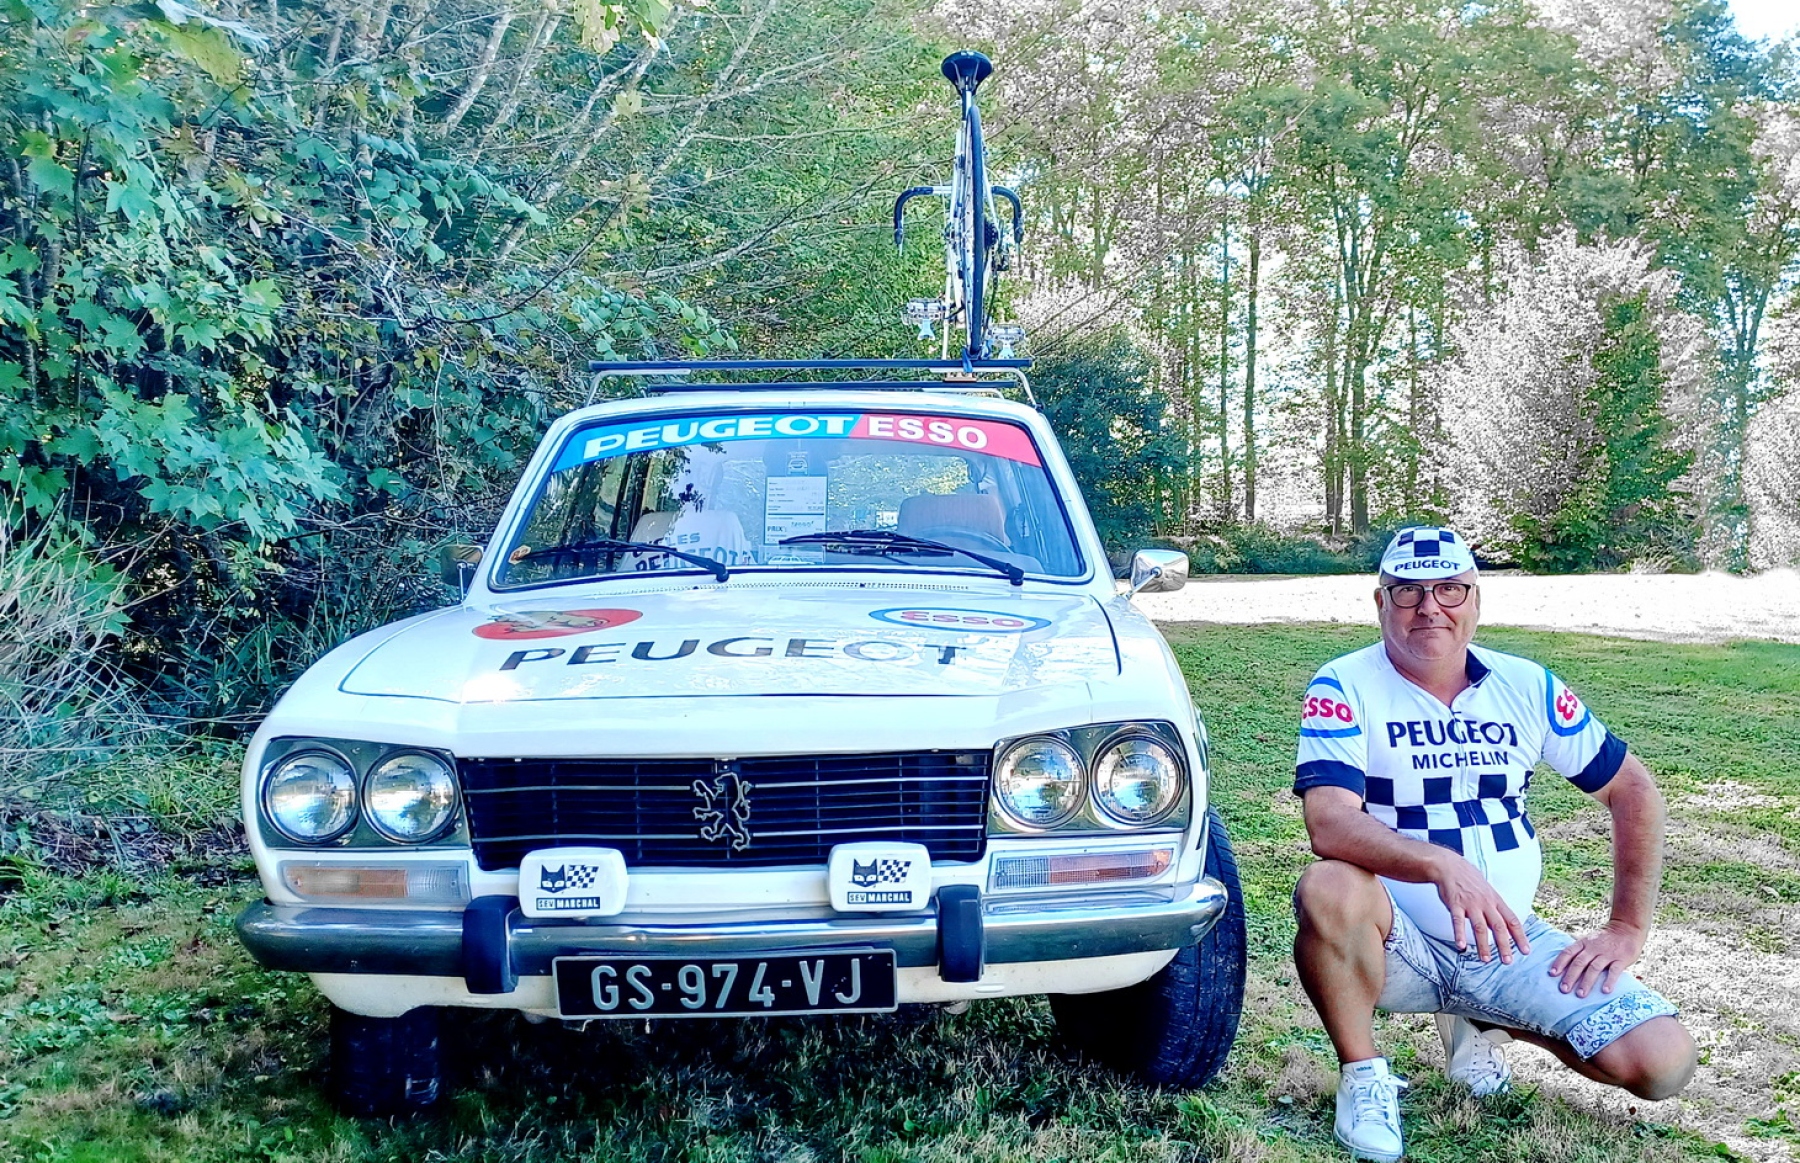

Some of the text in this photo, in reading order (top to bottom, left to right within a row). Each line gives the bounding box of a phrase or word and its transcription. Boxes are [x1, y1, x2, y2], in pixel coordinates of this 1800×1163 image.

[583, 415, 988, 459] PEUGEOT ESSO
[1394, 559, 1460, 572] PEUGEOT
[900, 611, 1024, 627] ESSO
[499, 636, 967, 671] PEUGEOT
[1386, 718, 1518, 748] PEUGEOT
[1412, 751, 1509, 769] MICHELIN
[556, 898, 599, 909] MARCHAL
[849, 892, 910, 902] SEV MARCHAL
[591, 958, 862, 1011] GS-974-VJ
